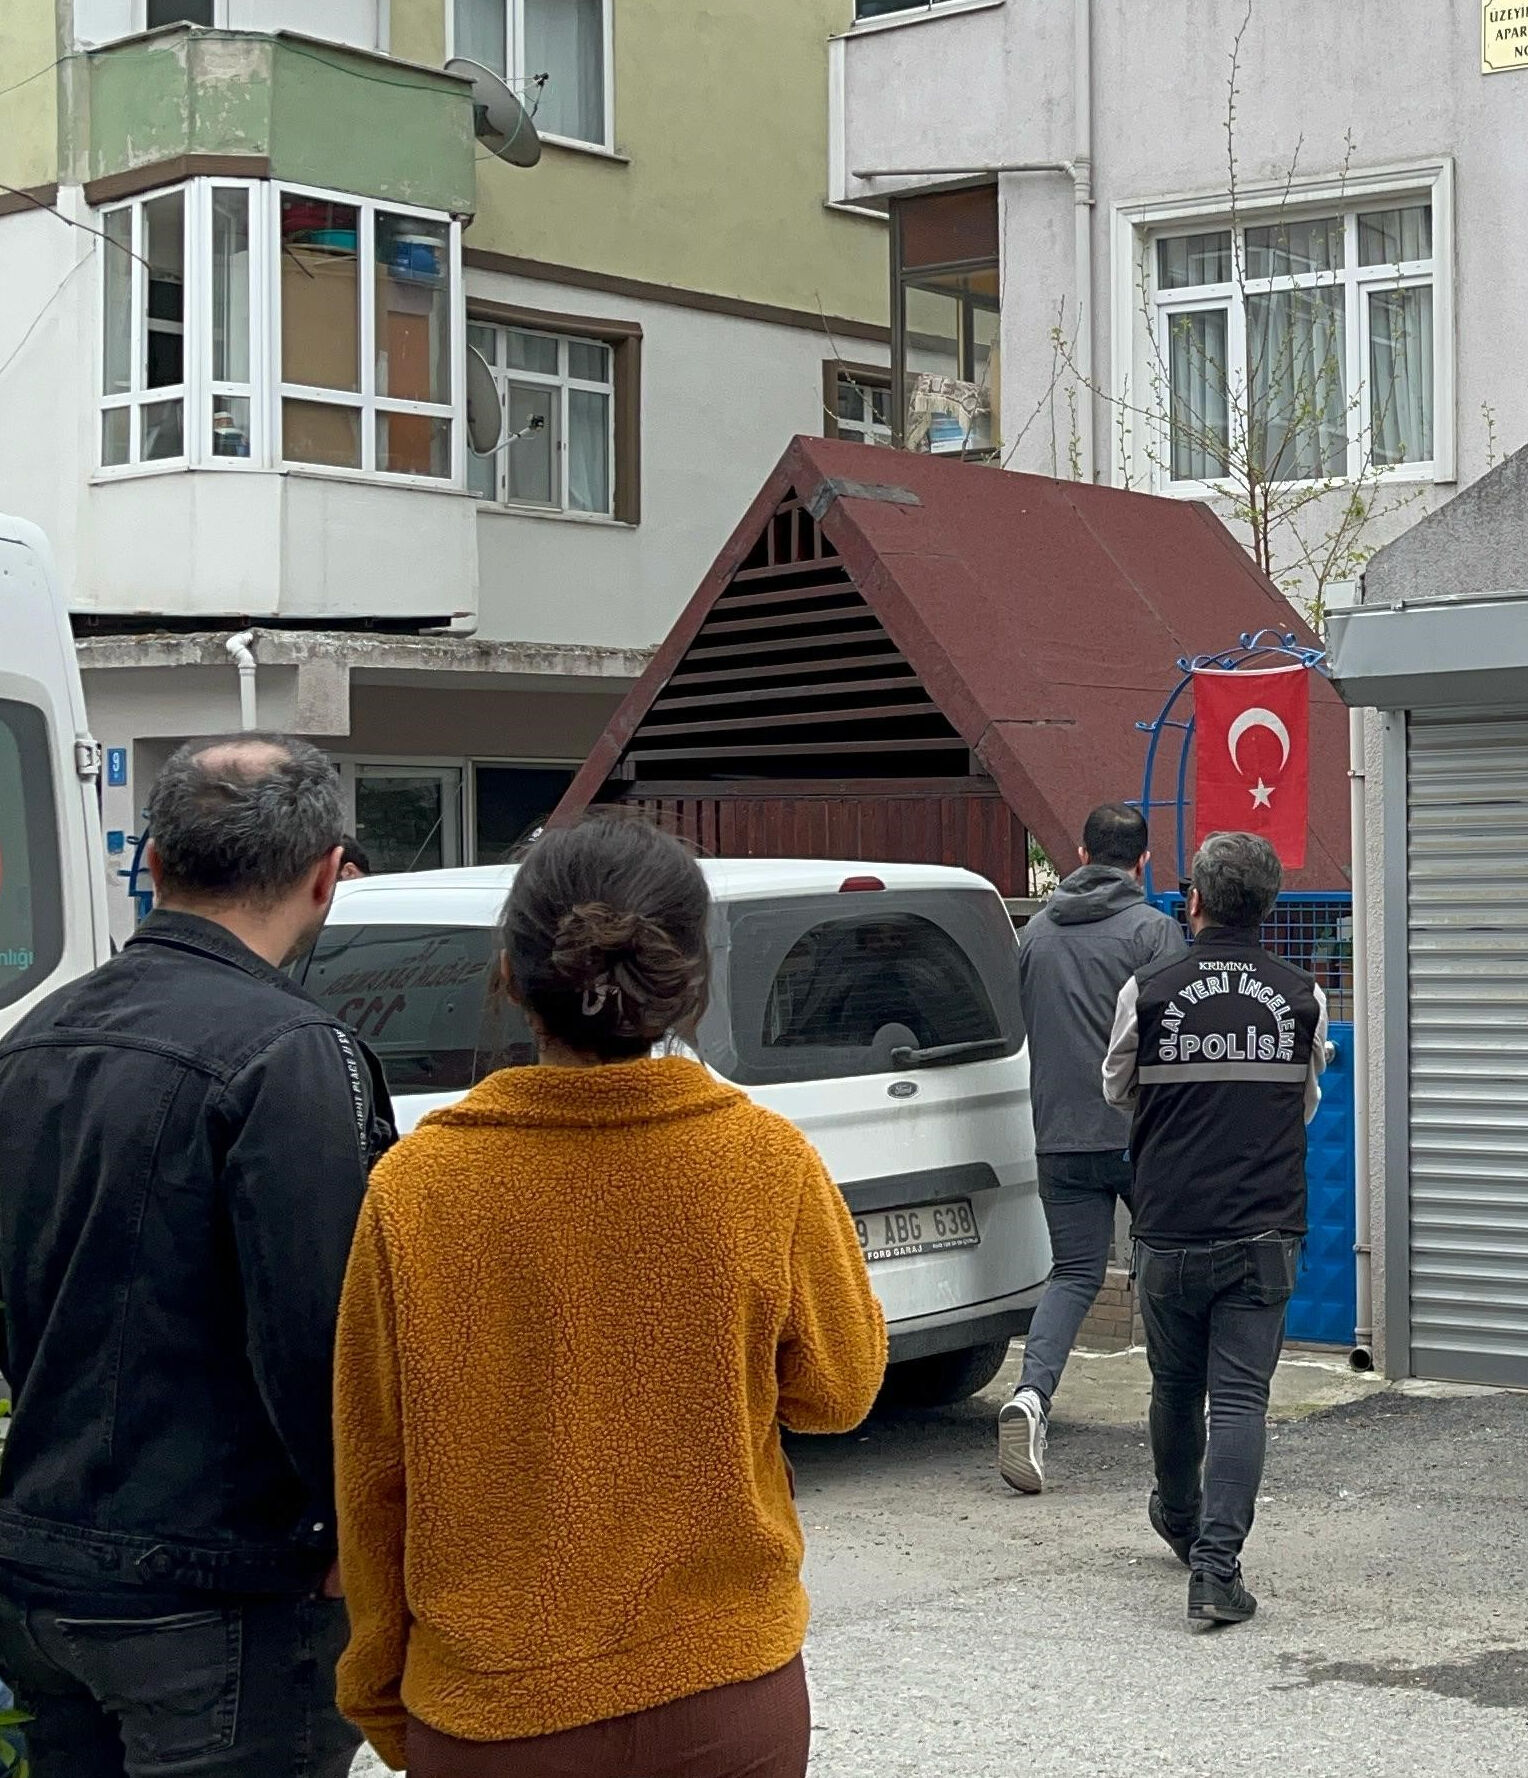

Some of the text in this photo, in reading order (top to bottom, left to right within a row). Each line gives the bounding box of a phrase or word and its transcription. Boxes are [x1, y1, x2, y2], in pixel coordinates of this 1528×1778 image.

[1199, 961, 1257, 972] KRİMİNAL
[1158, 971, 1295, 1062] OLAY YERİ İNCELEME
[1180, 1025, 1276, 1061] POLİS
[856, 1206, 971, 1248] 9 ABG 638
